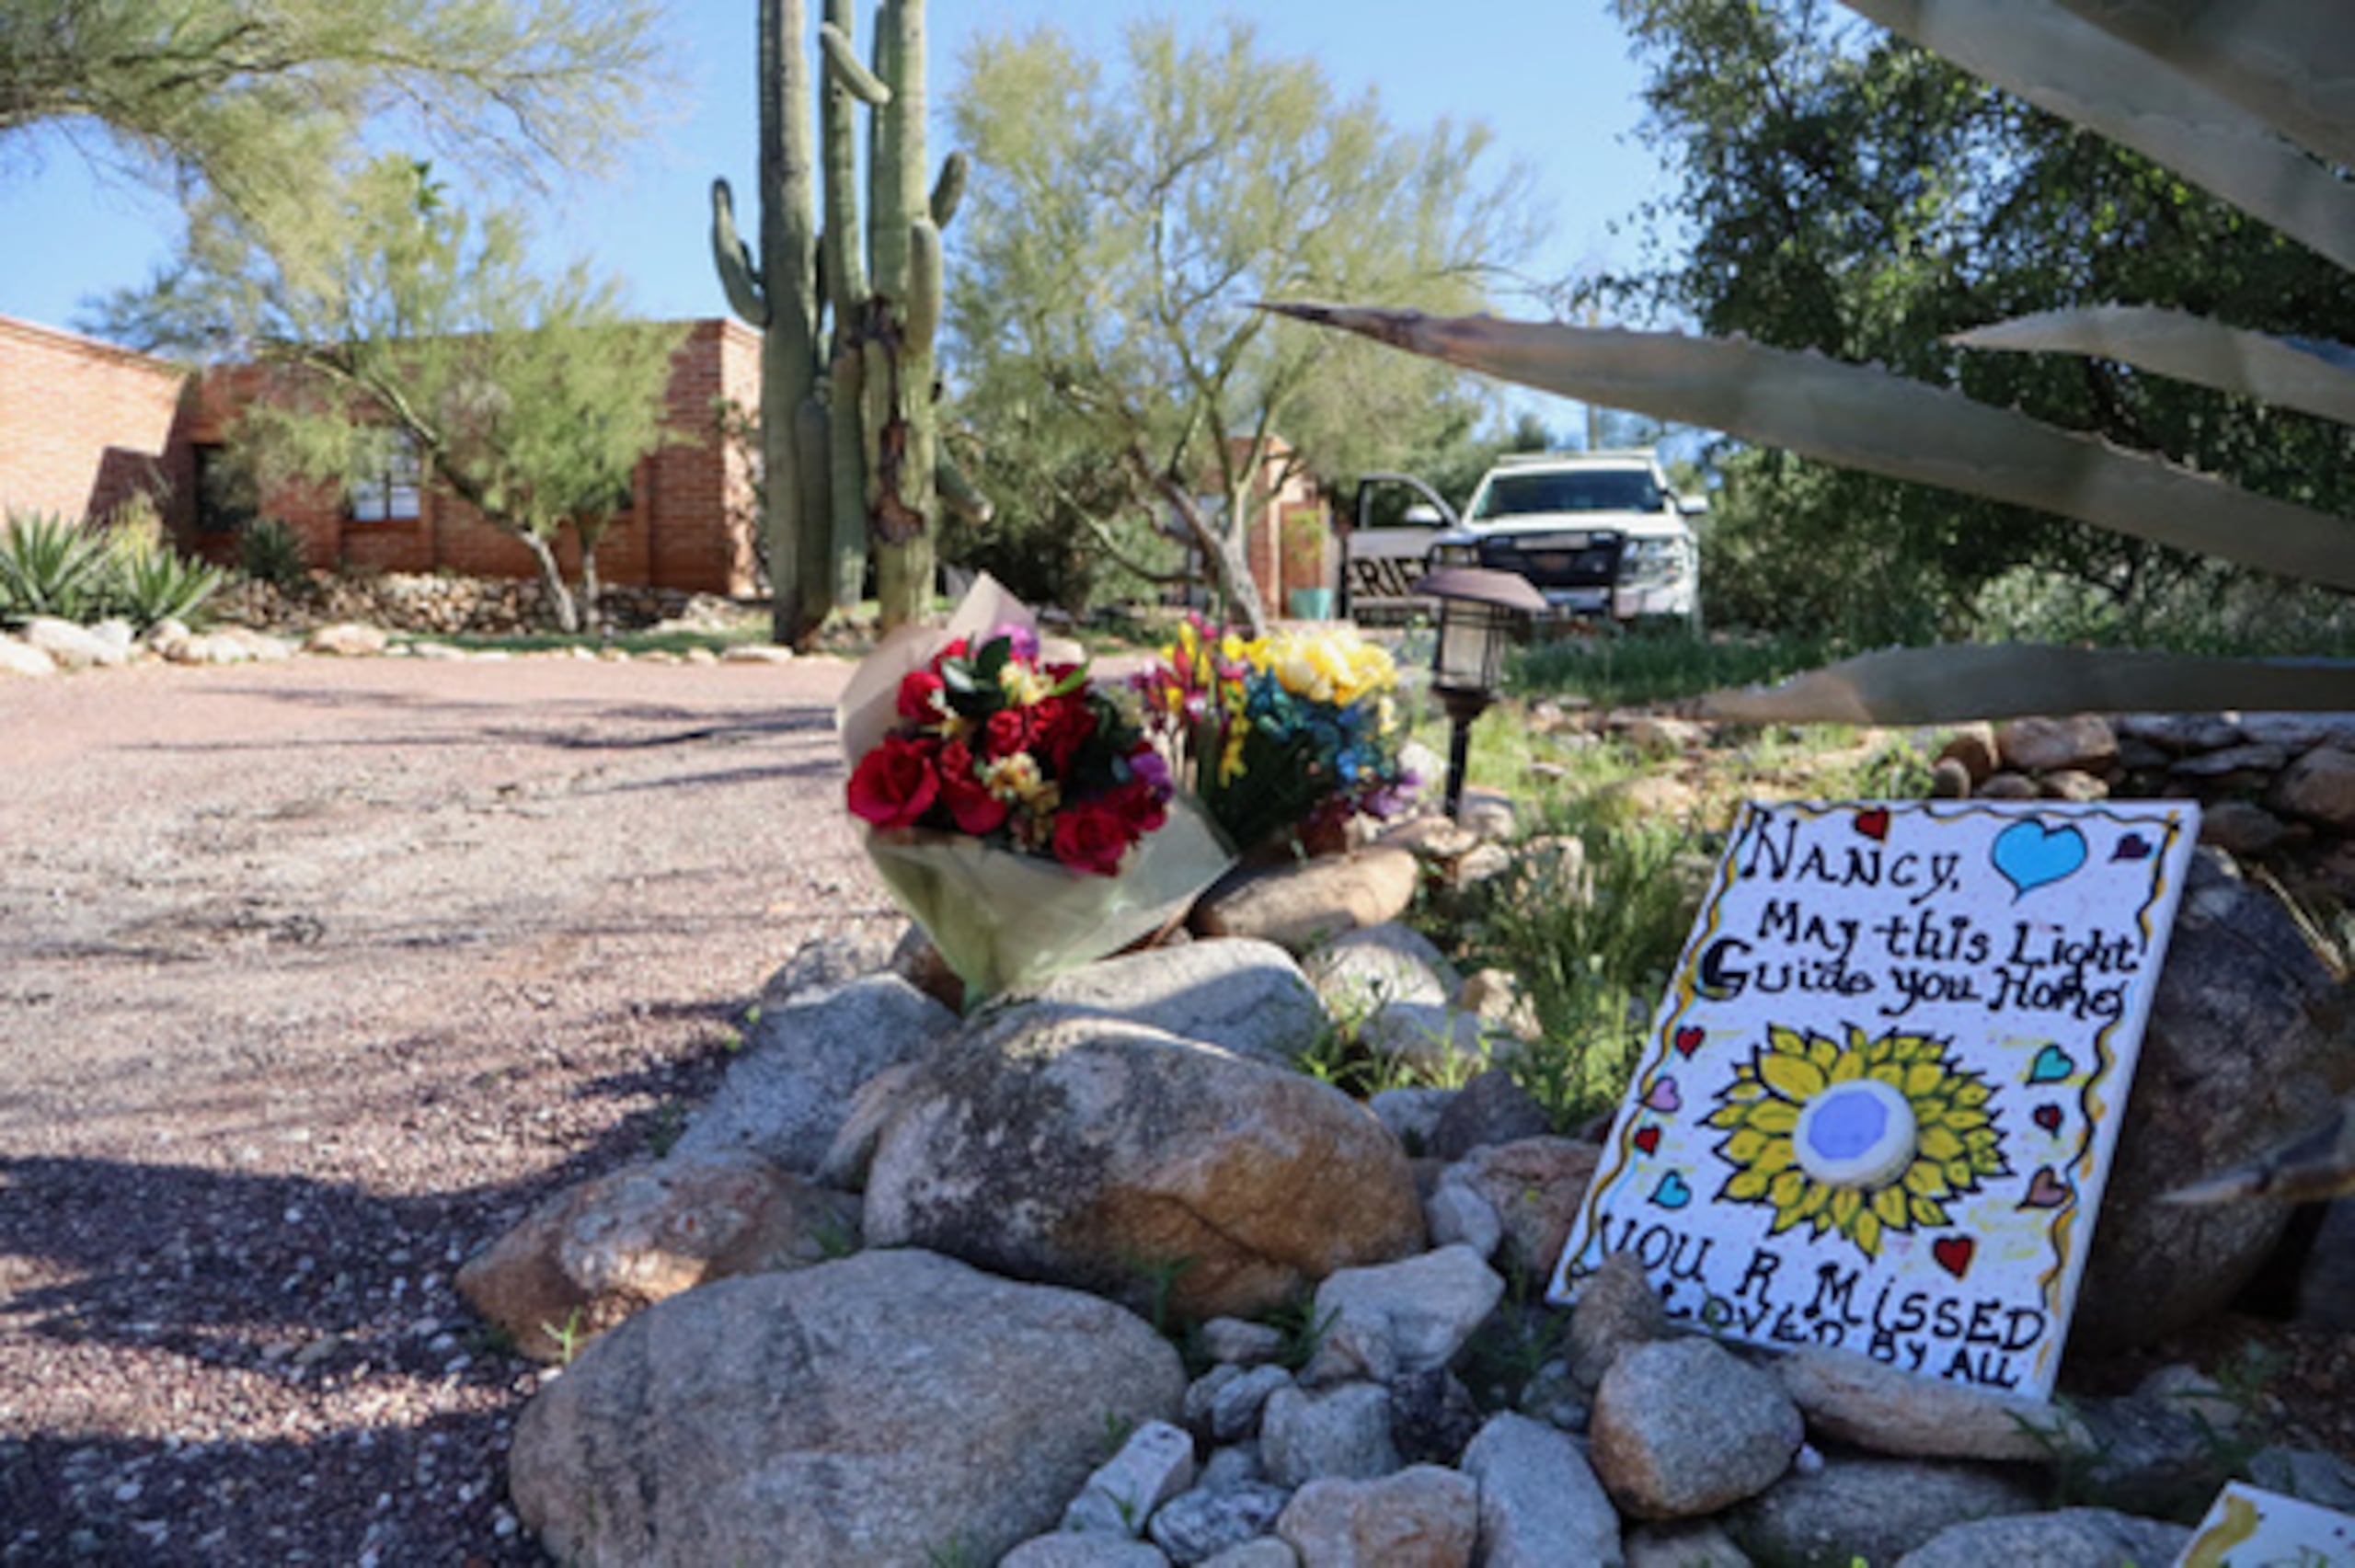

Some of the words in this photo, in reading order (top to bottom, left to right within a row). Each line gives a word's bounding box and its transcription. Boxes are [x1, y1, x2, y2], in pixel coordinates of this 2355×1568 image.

[1347, 556, 1430, 597] RIF
[1872, 909, 1990, 964] this
[1878, 967, 1982, 1016] you
[1734, 1246, 1781, 1310] R
